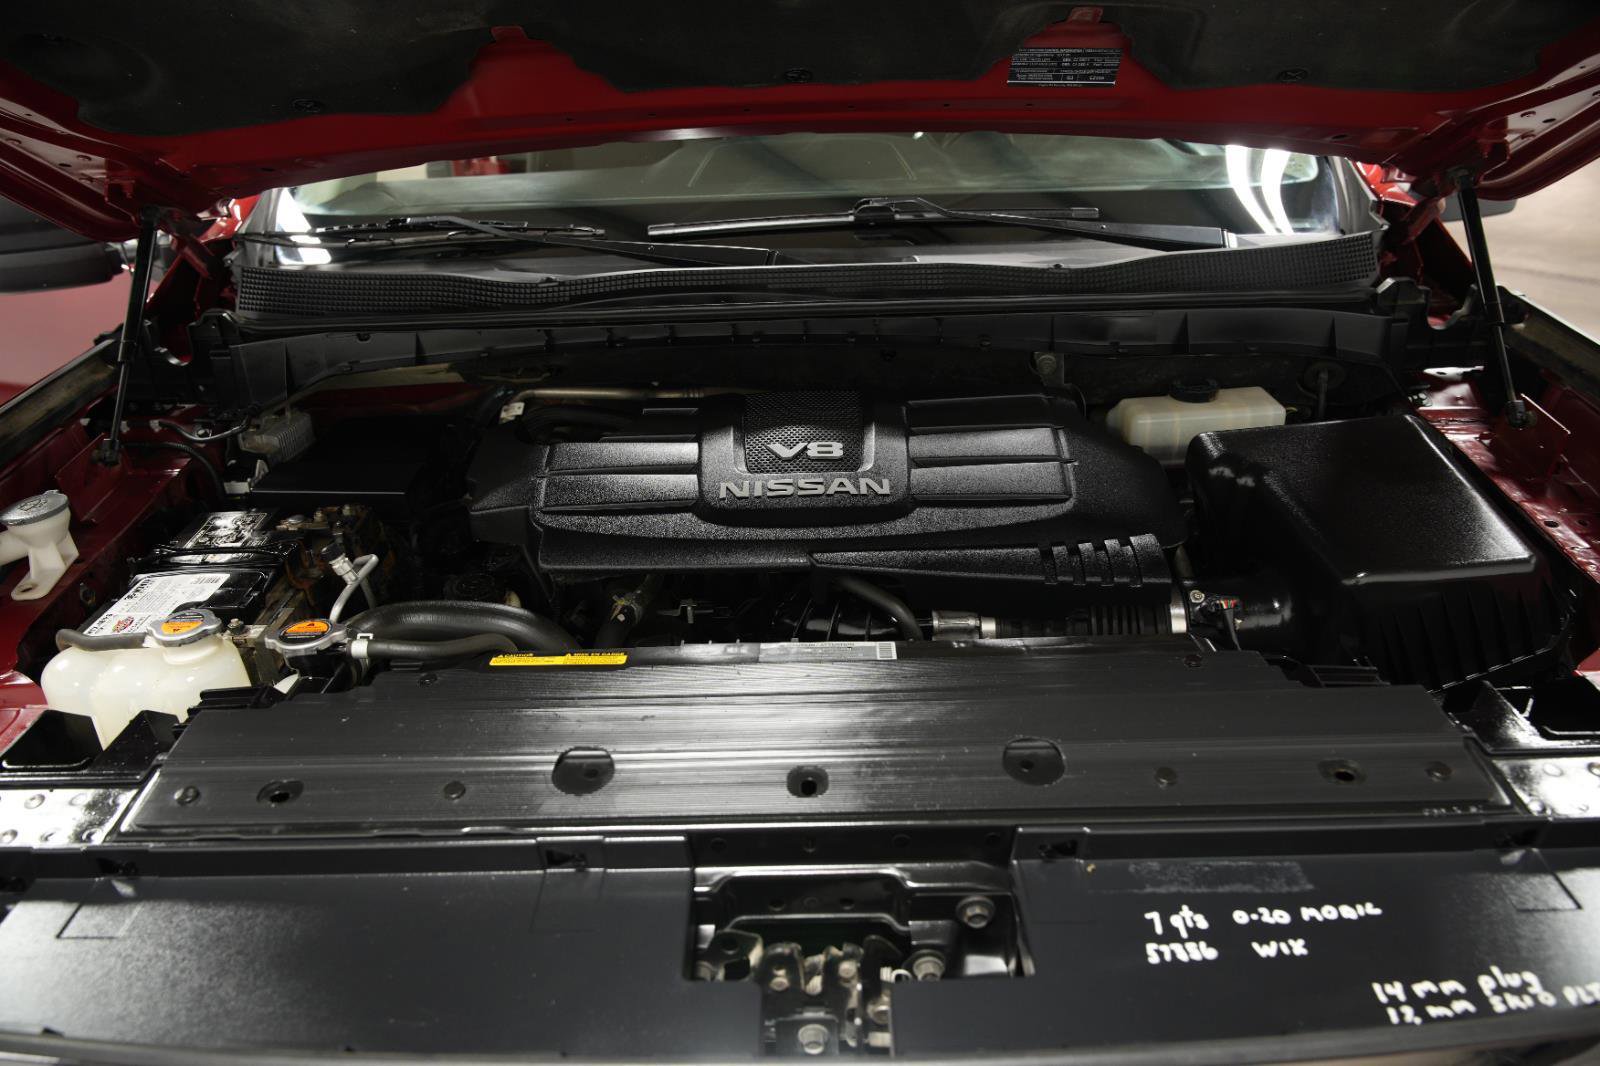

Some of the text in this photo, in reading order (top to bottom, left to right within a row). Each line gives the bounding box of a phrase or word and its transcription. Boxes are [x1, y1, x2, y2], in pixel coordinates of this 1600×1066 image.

[765, 441, 844, 461] V8
[719, 477, 891, 499] NISSAN
[1143, 910, 1163, 936] 7
[1169, 904, 1210, 939] qts
[1231, 906, 1292, 925] 0-20
[1251, 938, 1309, 959] WIX
[1372, 981, 1407, 1004] 14
[1477, 965, 1543, 998] plug
